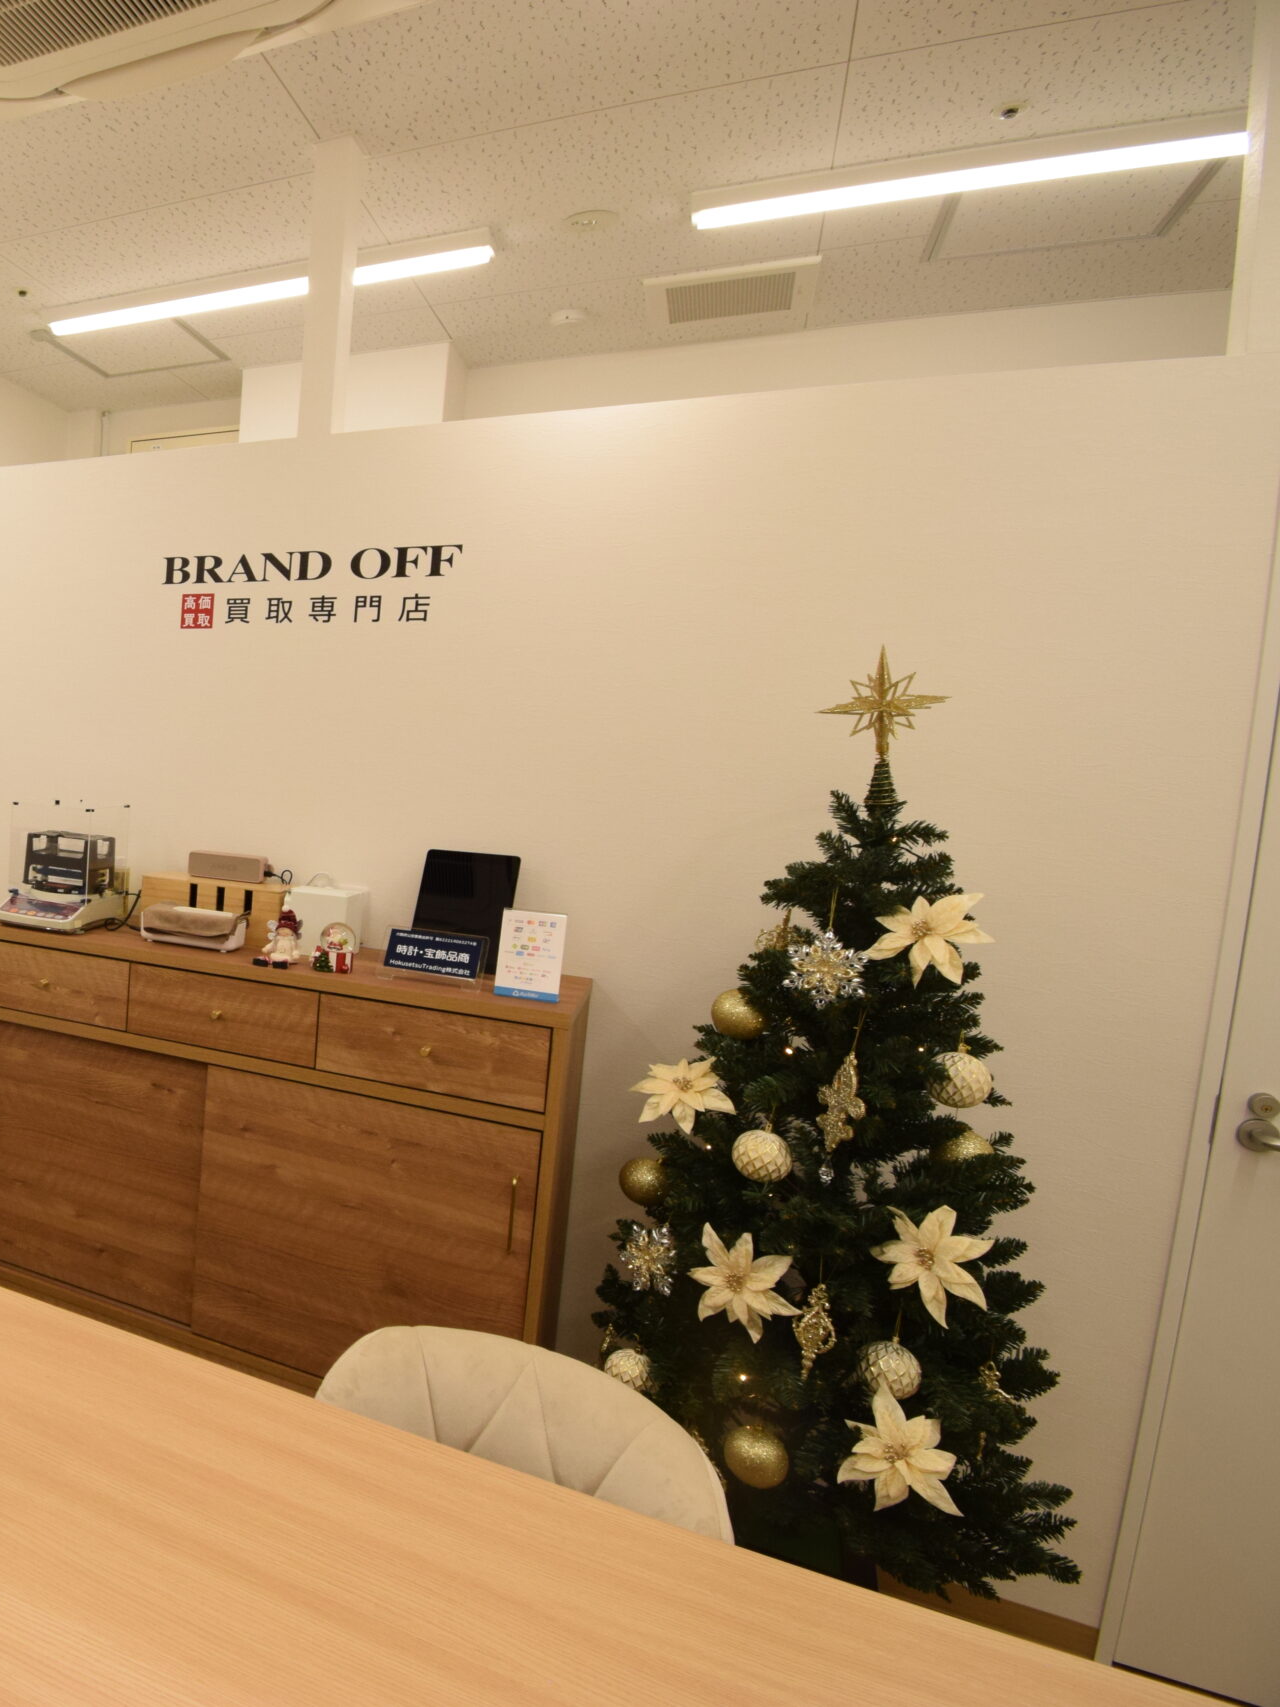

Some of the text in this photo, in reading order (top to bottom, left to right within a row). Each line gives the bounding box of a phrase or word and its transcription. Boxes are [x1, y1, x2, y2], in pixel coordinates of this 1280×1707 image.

[161, 544, 464, 585] BRAND OFF
[183, 593, 431, 625] 高価 買取専門店
[182, 612, 211, 628] 買取
[396, 944, 470, 964] 時計・宝飾品商
[389, 958, 471, 976] HokusetsuTrading株式会社
